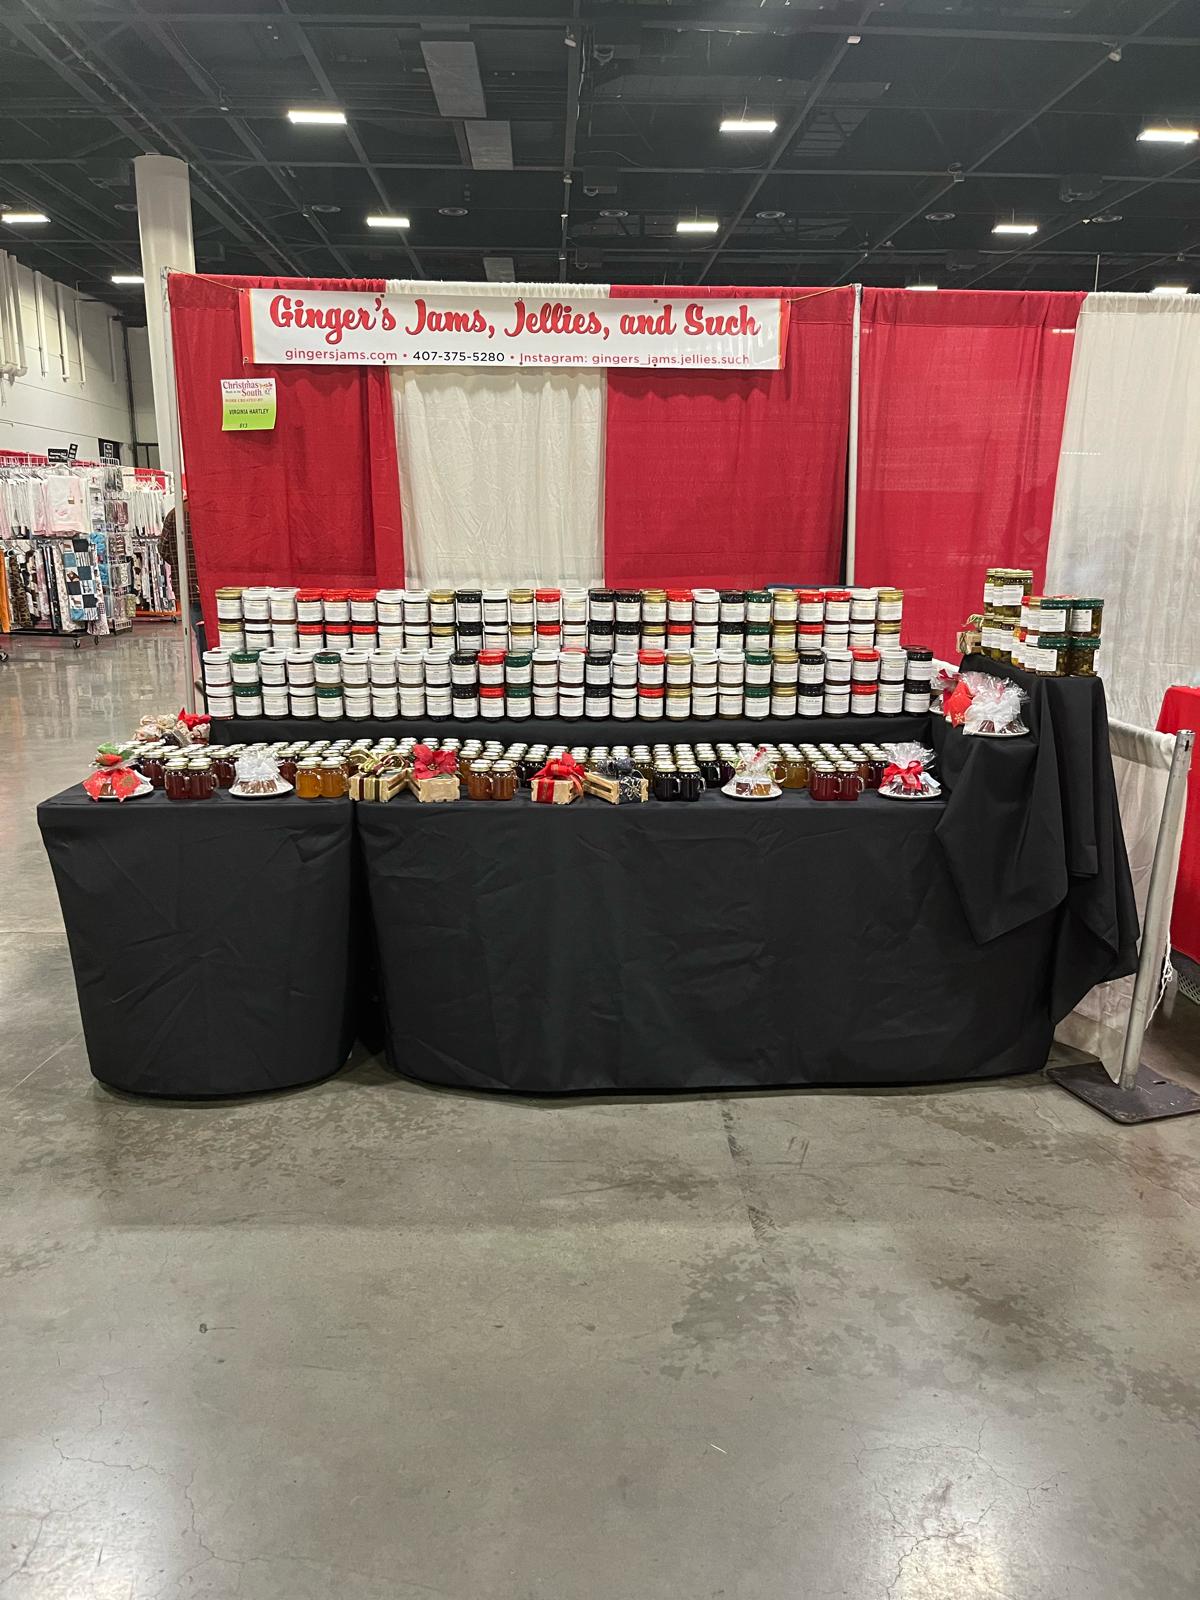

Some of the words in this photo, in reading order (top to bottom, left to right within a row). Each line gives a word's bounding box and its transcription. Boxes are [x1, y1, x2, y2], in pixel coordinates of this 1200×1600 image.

[269, 294, 397, 345] Ginger's
[405, 298, 495, 339] Jams,
[503, 300, 610, 340] Jellies,
[619, 303, 677, 336] and
[683, 303, 762, 336] Such
[285, 348, 398, 362] gingersjams.com
[412, 350, 505, 362] 407-375-5280
[520, 353, 587, 366] Instagram:
[592, 353, 749, 366] gingers_jams.jellies.such
[222, 380, 259, 390] Christmas
[241, 389, 262, 397] South
